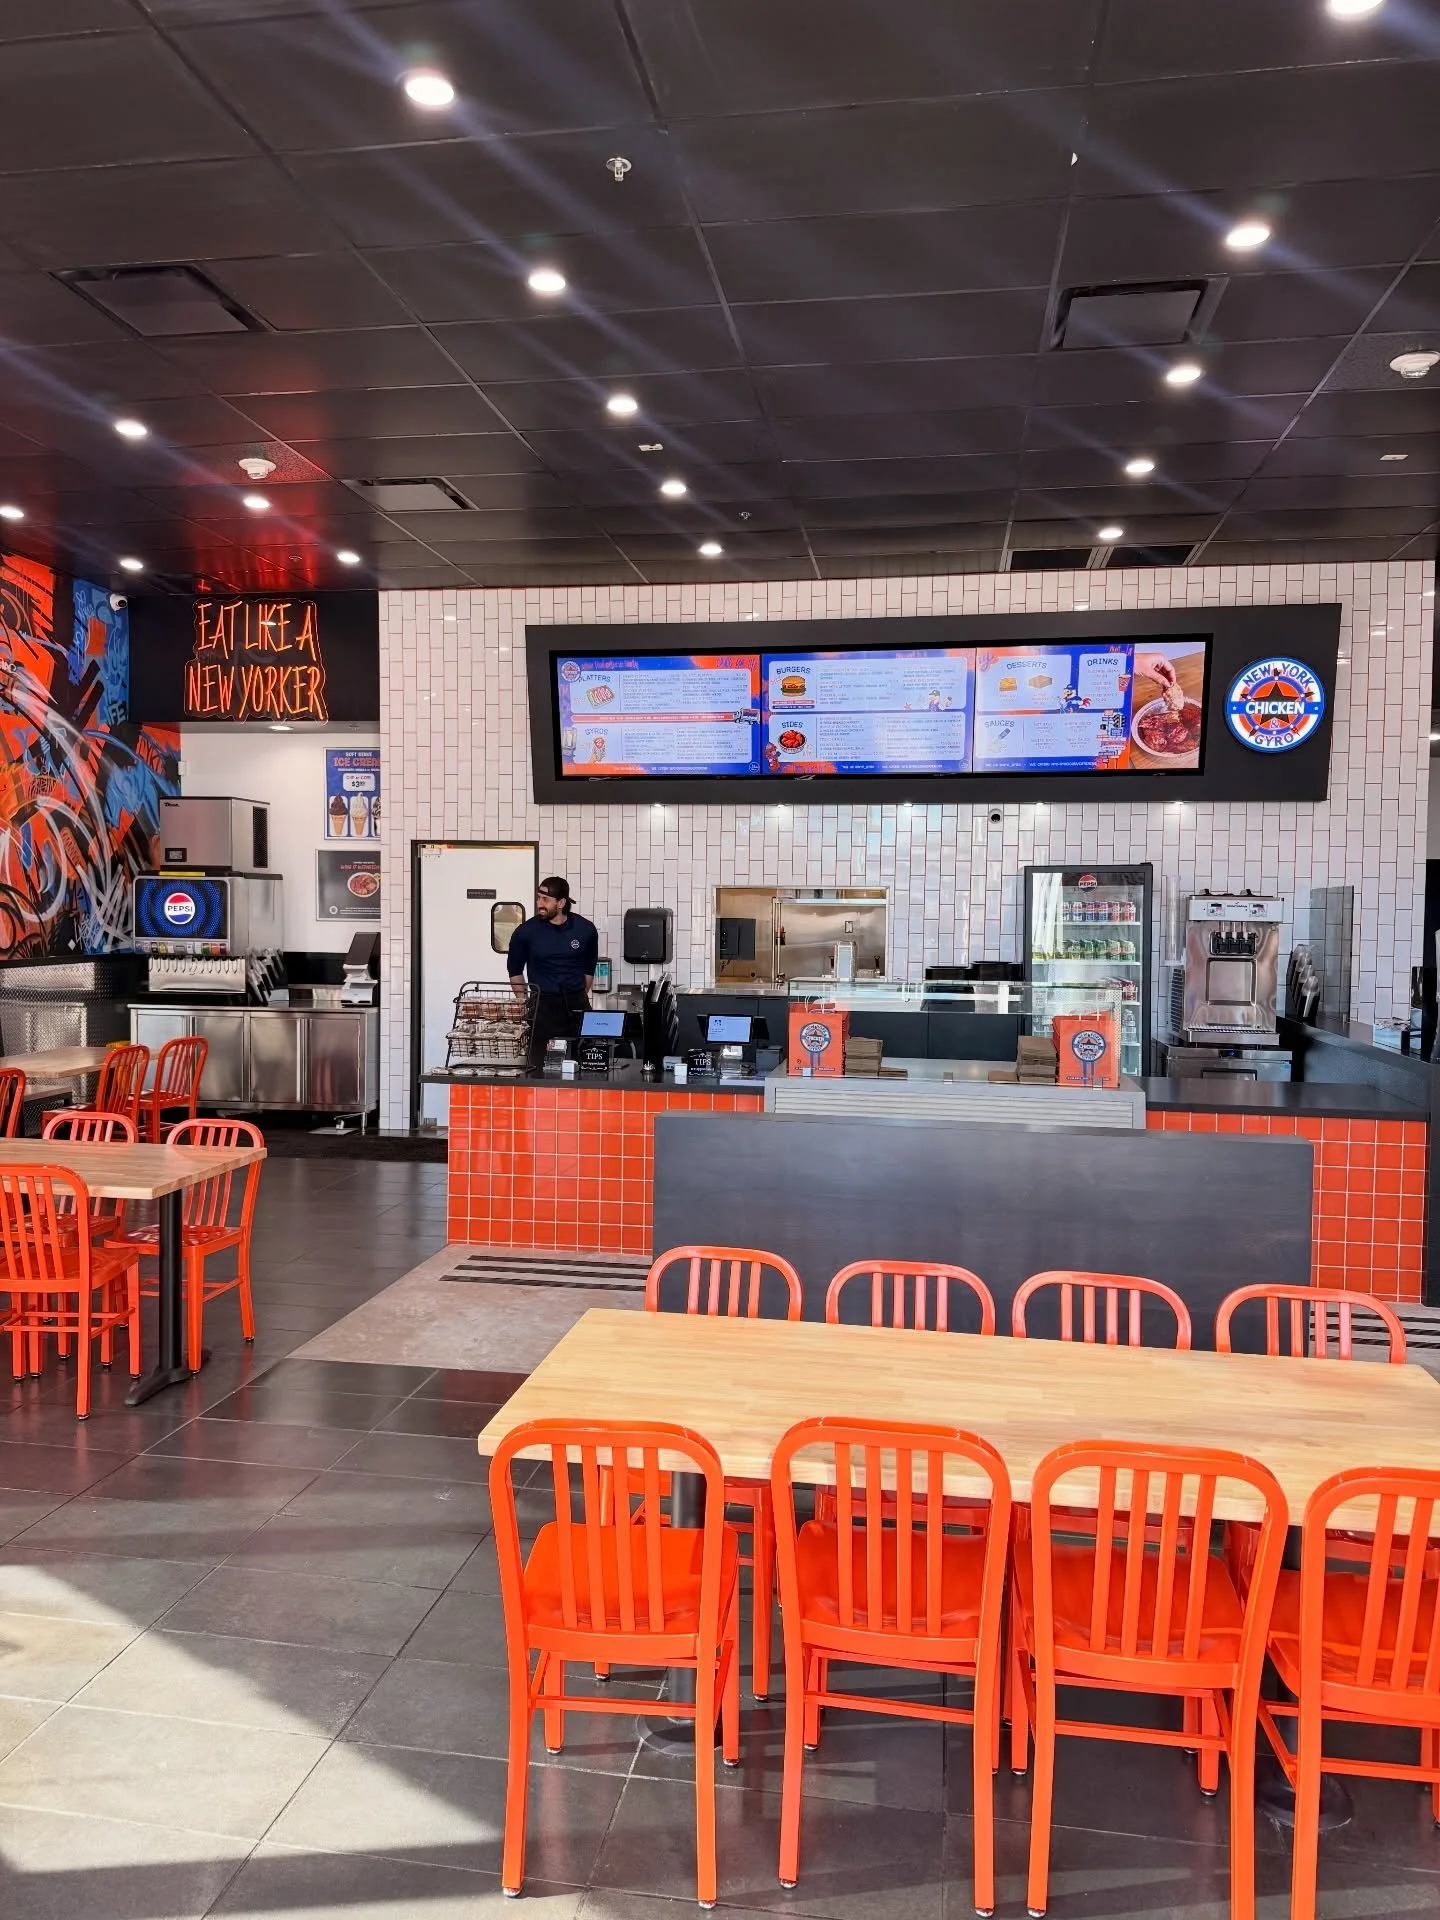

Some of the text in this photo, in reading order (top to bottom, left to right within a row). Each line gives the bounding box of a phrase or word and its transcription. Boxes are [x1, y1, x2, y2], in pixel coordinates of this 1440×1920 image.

[197, 601, 317, 661] EAT LIKE A
[1006, 660, 1048, 670] DESSERTS
[1086, 658, 1119, 667] DRINKS
[776, 666, 812, 675] BURGERS
[1242, 663, 1314, 688] NEW YORK
[578, 674, 612, 683] PLATTERS
[189, 662, 325, 720] NEW YORKER
[1245, 701, 1305, 715] CHICKEN
[781, 721, 804, 729] SIDES
[984, 719, 1016, 729] SAUCES
[1270, 719, 1280, 729] &
[584, 728, 609, 736] GYROS
[1254, 733, 1295, 747] GYRO
[333, 757, 351, 767] ICE
[167, 905, 193, 913] PEPSI
